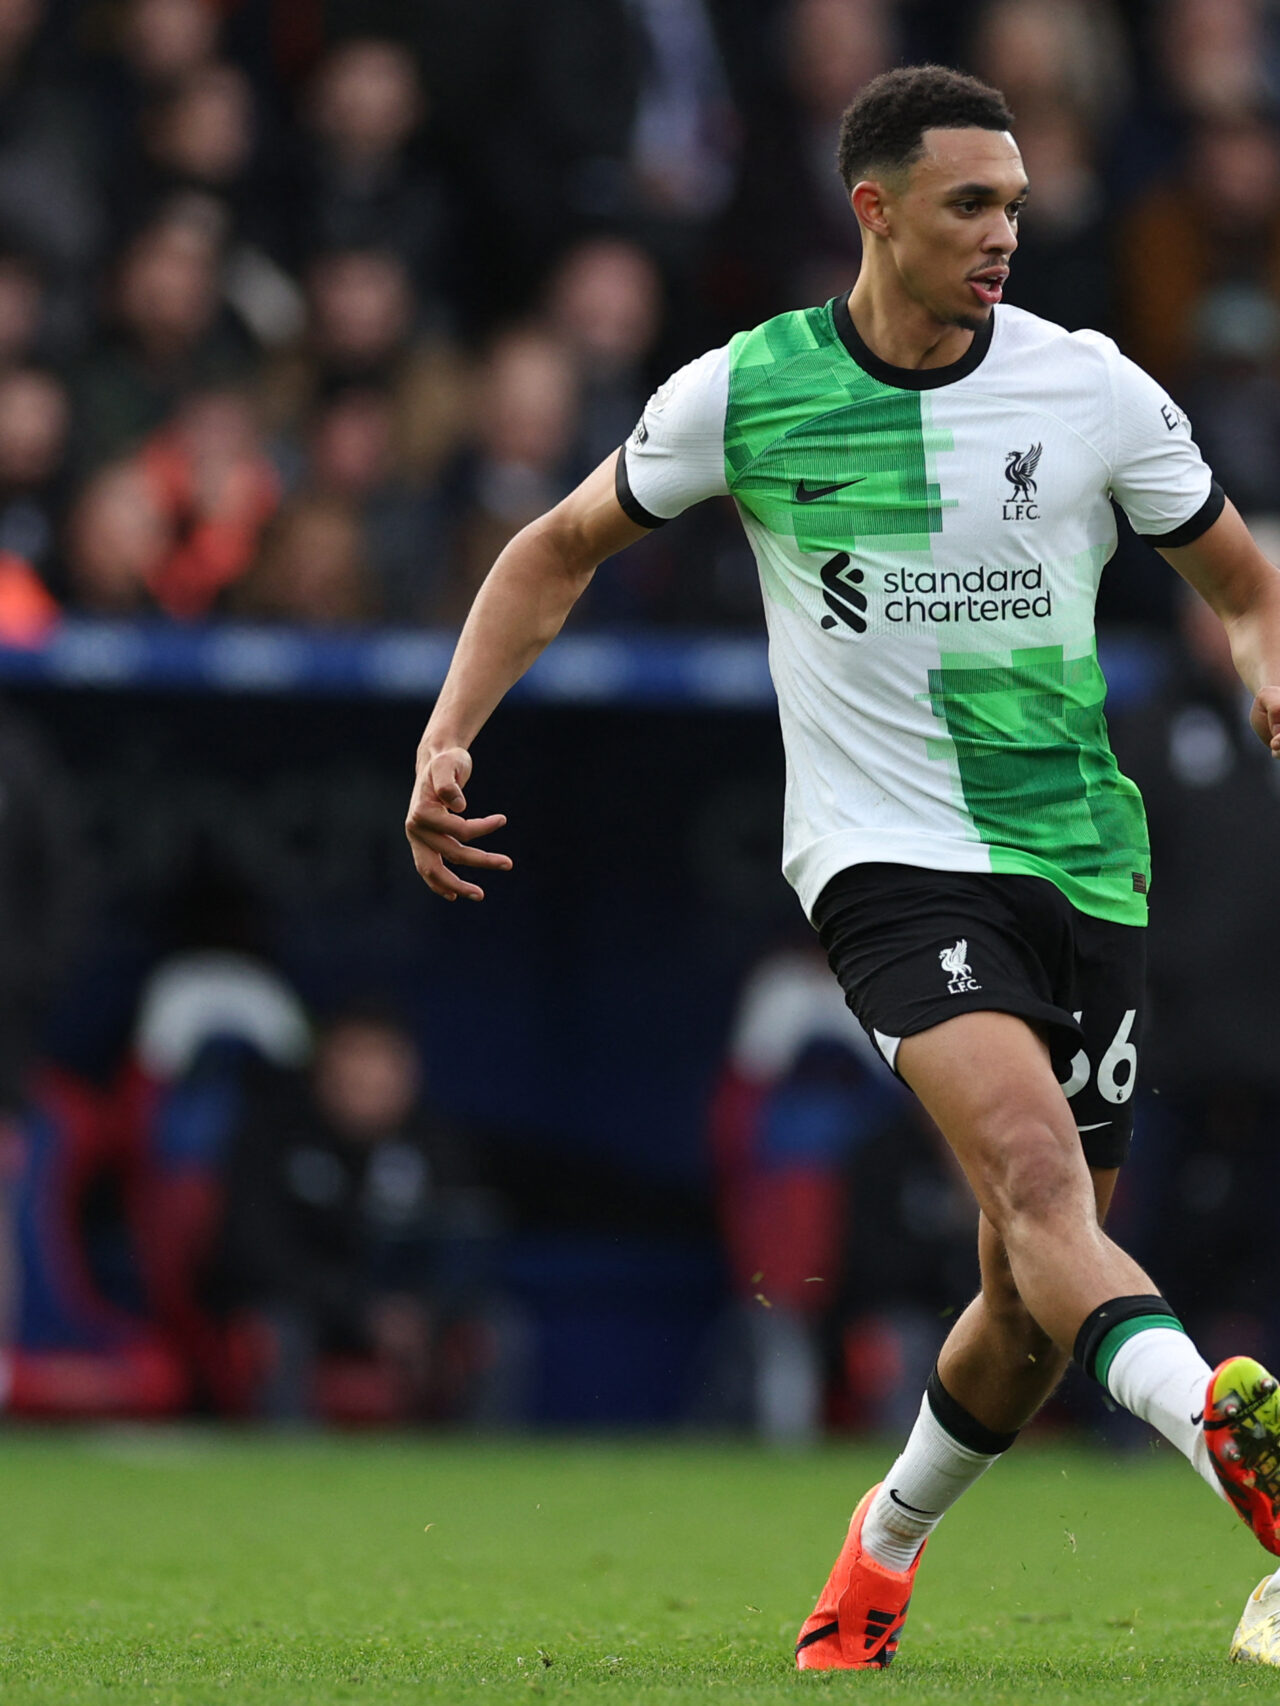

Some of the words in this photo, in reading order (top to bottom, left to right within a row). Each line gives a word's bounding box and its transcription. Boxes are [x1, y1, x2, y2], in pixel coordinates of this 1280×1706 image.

[1002, 504, 1041, 521] L.F.C.
[883, 562, 1042, 594] standard
[884, 590, 1052, 622] chartered
[947, 979, 982, 995] L.F.C.
